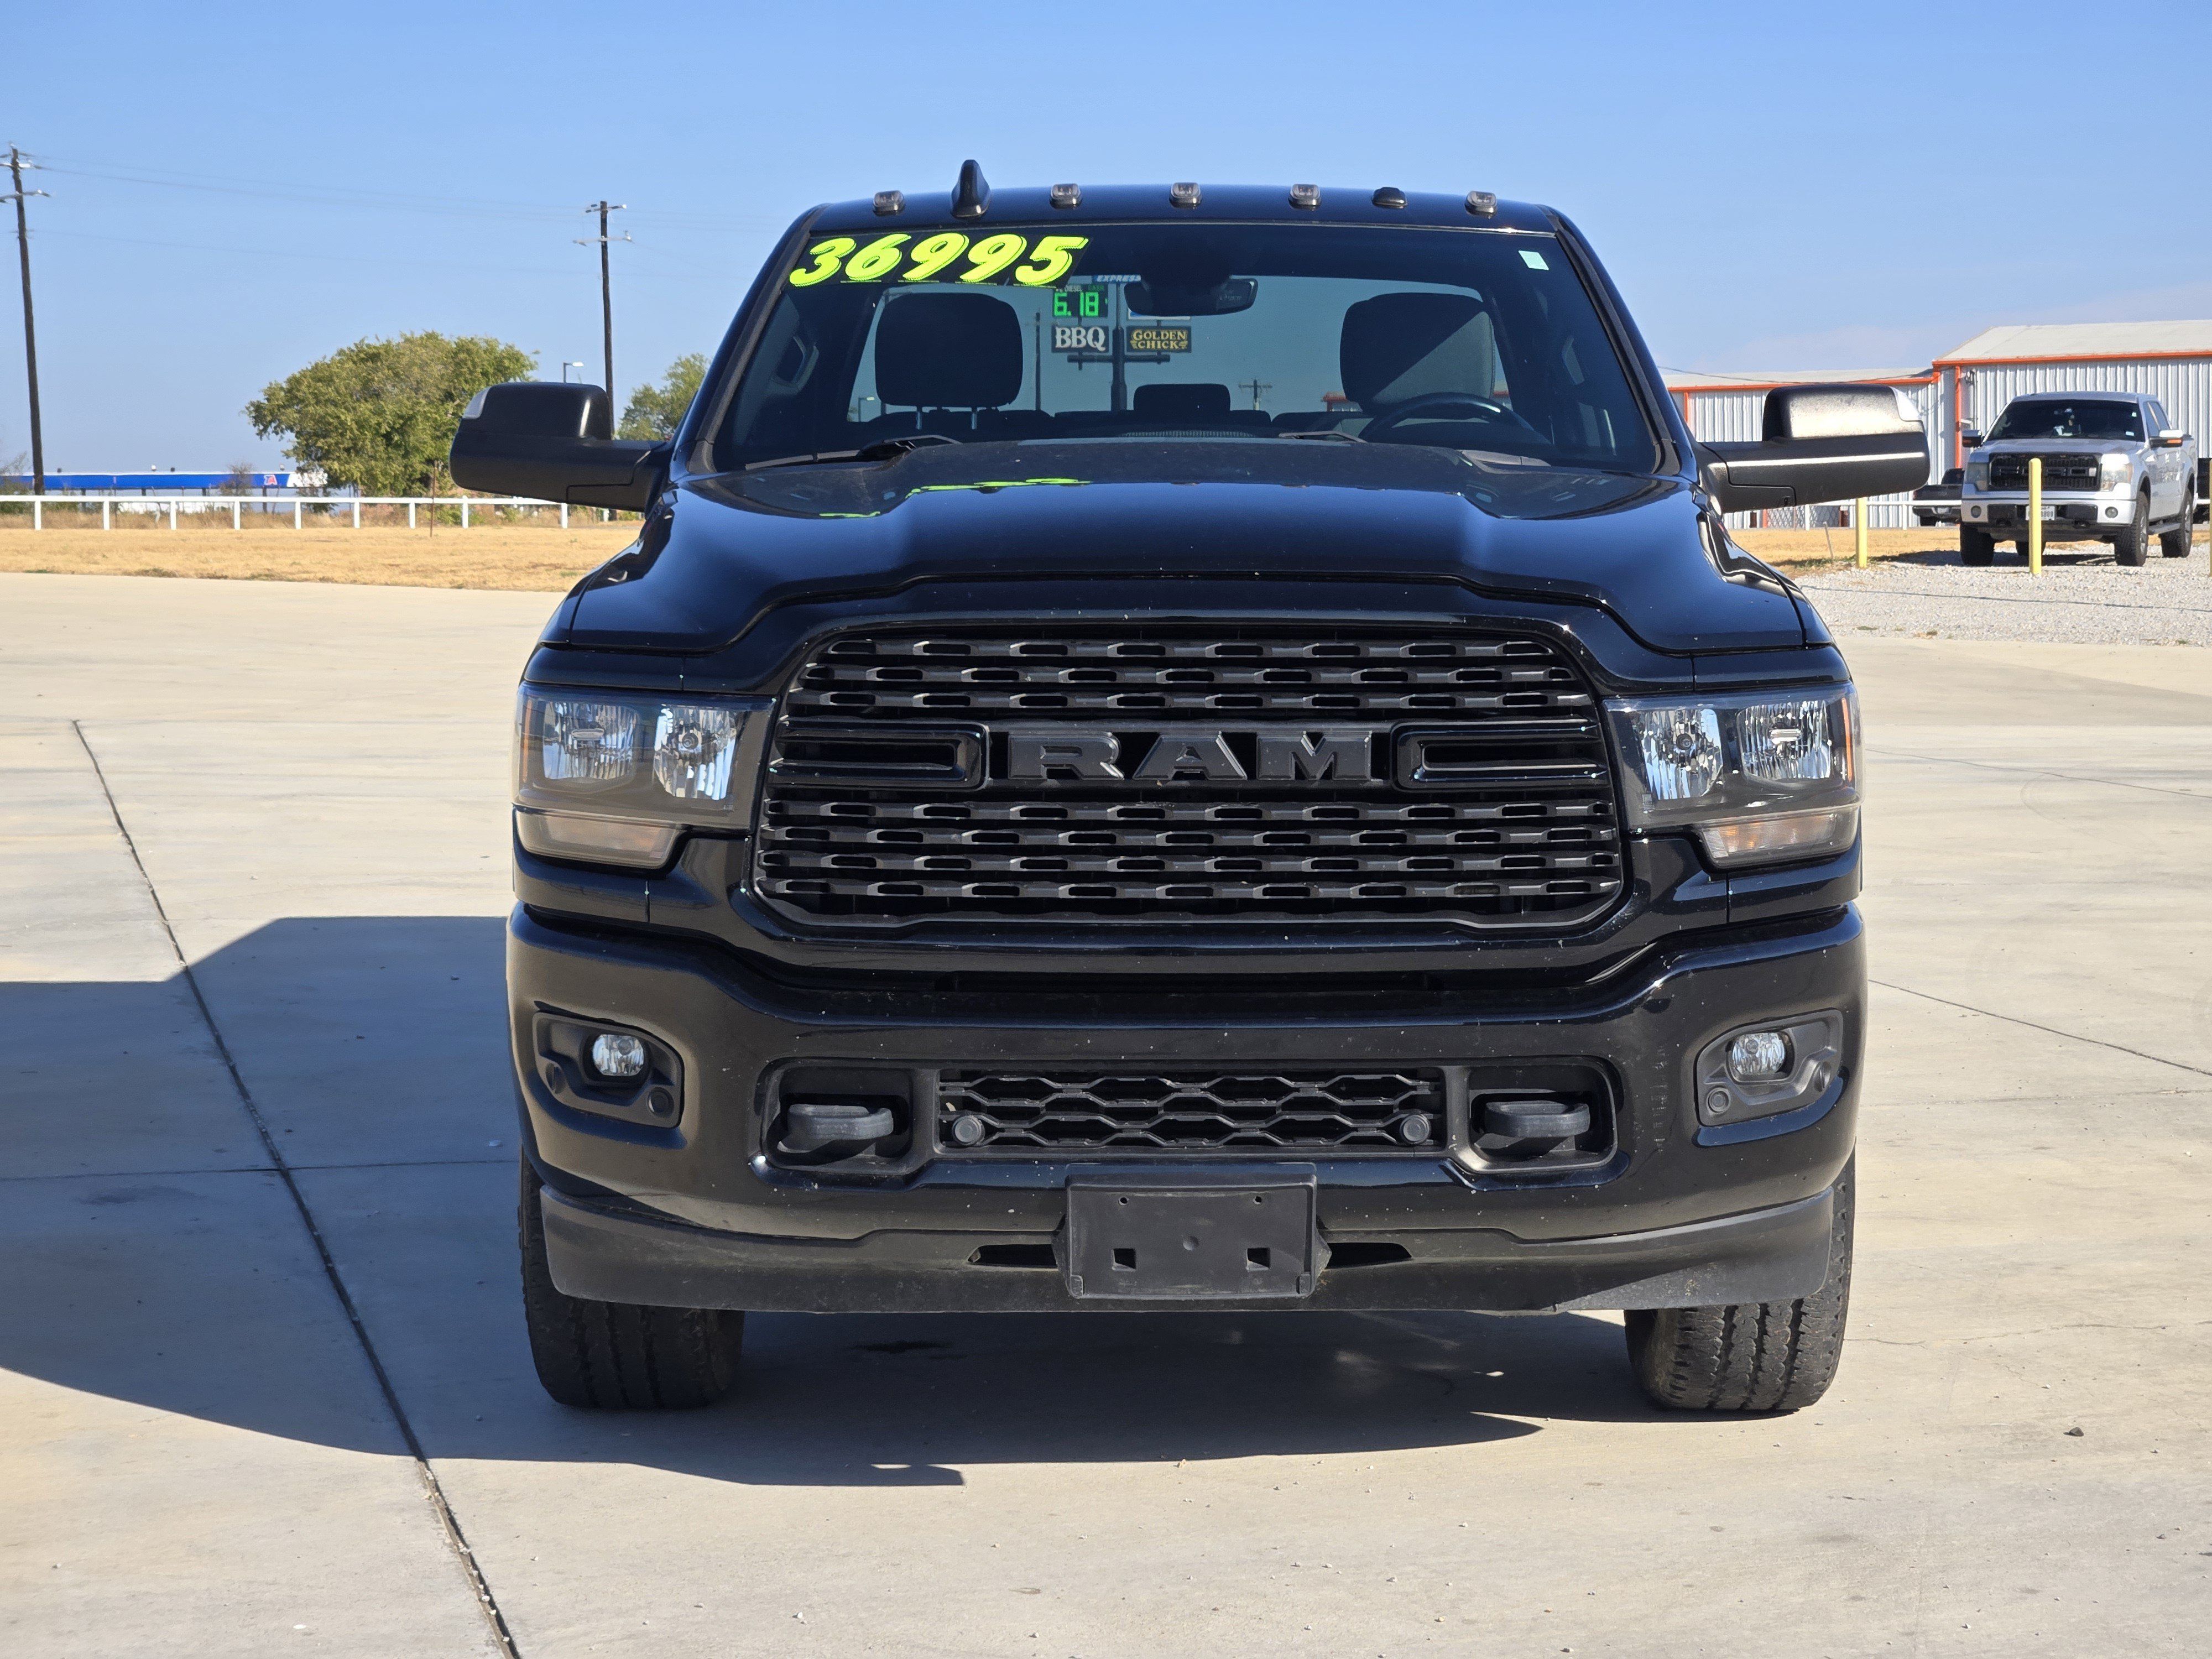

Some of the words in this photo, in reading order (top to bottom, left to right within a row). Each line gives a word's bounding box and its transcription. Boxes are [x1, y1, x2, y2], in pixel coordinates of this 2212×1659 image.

[789, 233, 1089, 287] 36995
[1097, 274, 1141, 283] EXPRESS
[1054, 291, 1099, 316] 6.18
[1055, 326, 1106, 351] BBQ
[1133, 330, 1187, 340] GOLDEN
[1138, 340, 1180, 349] CHICK
[1007, 731, 1372, 780] RAM
